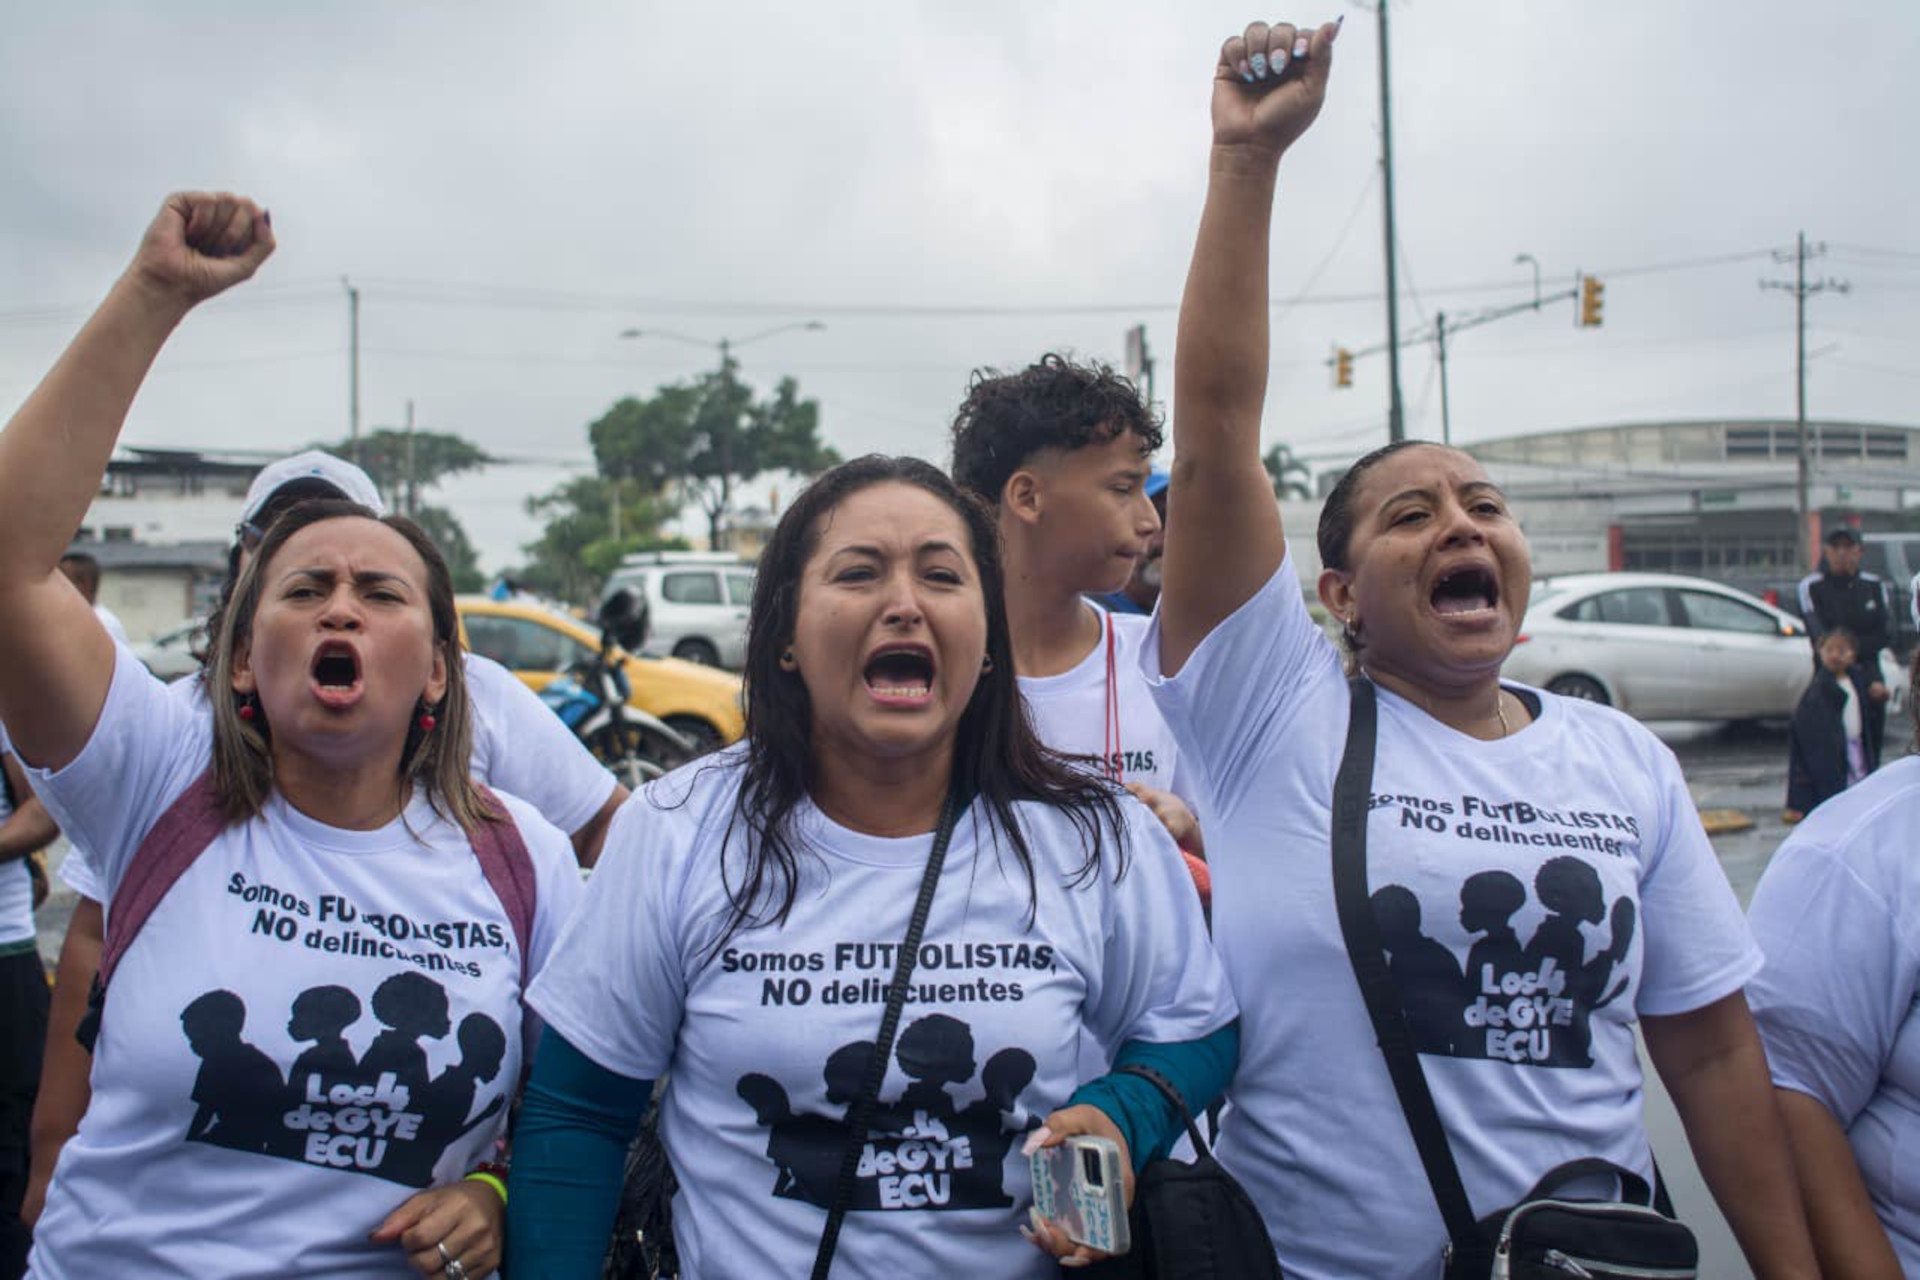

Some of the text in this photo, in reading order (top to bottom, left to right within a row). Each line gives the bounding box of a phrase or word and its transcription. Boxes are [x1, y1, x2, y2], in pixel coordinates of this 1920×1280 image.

[1401, 807, 1447, 833] NO
[228, 872, 311, 916] Somos
[252, 909, 298, 941] NO
[721, 948, 824, 973] Somos
[761, 978, 811, 1006] NO
[1486, 1028, 1550, 1061] ECU
[305, 1132, 387, 1169] ECU
[878, 1173, 950, 1208] ECU
